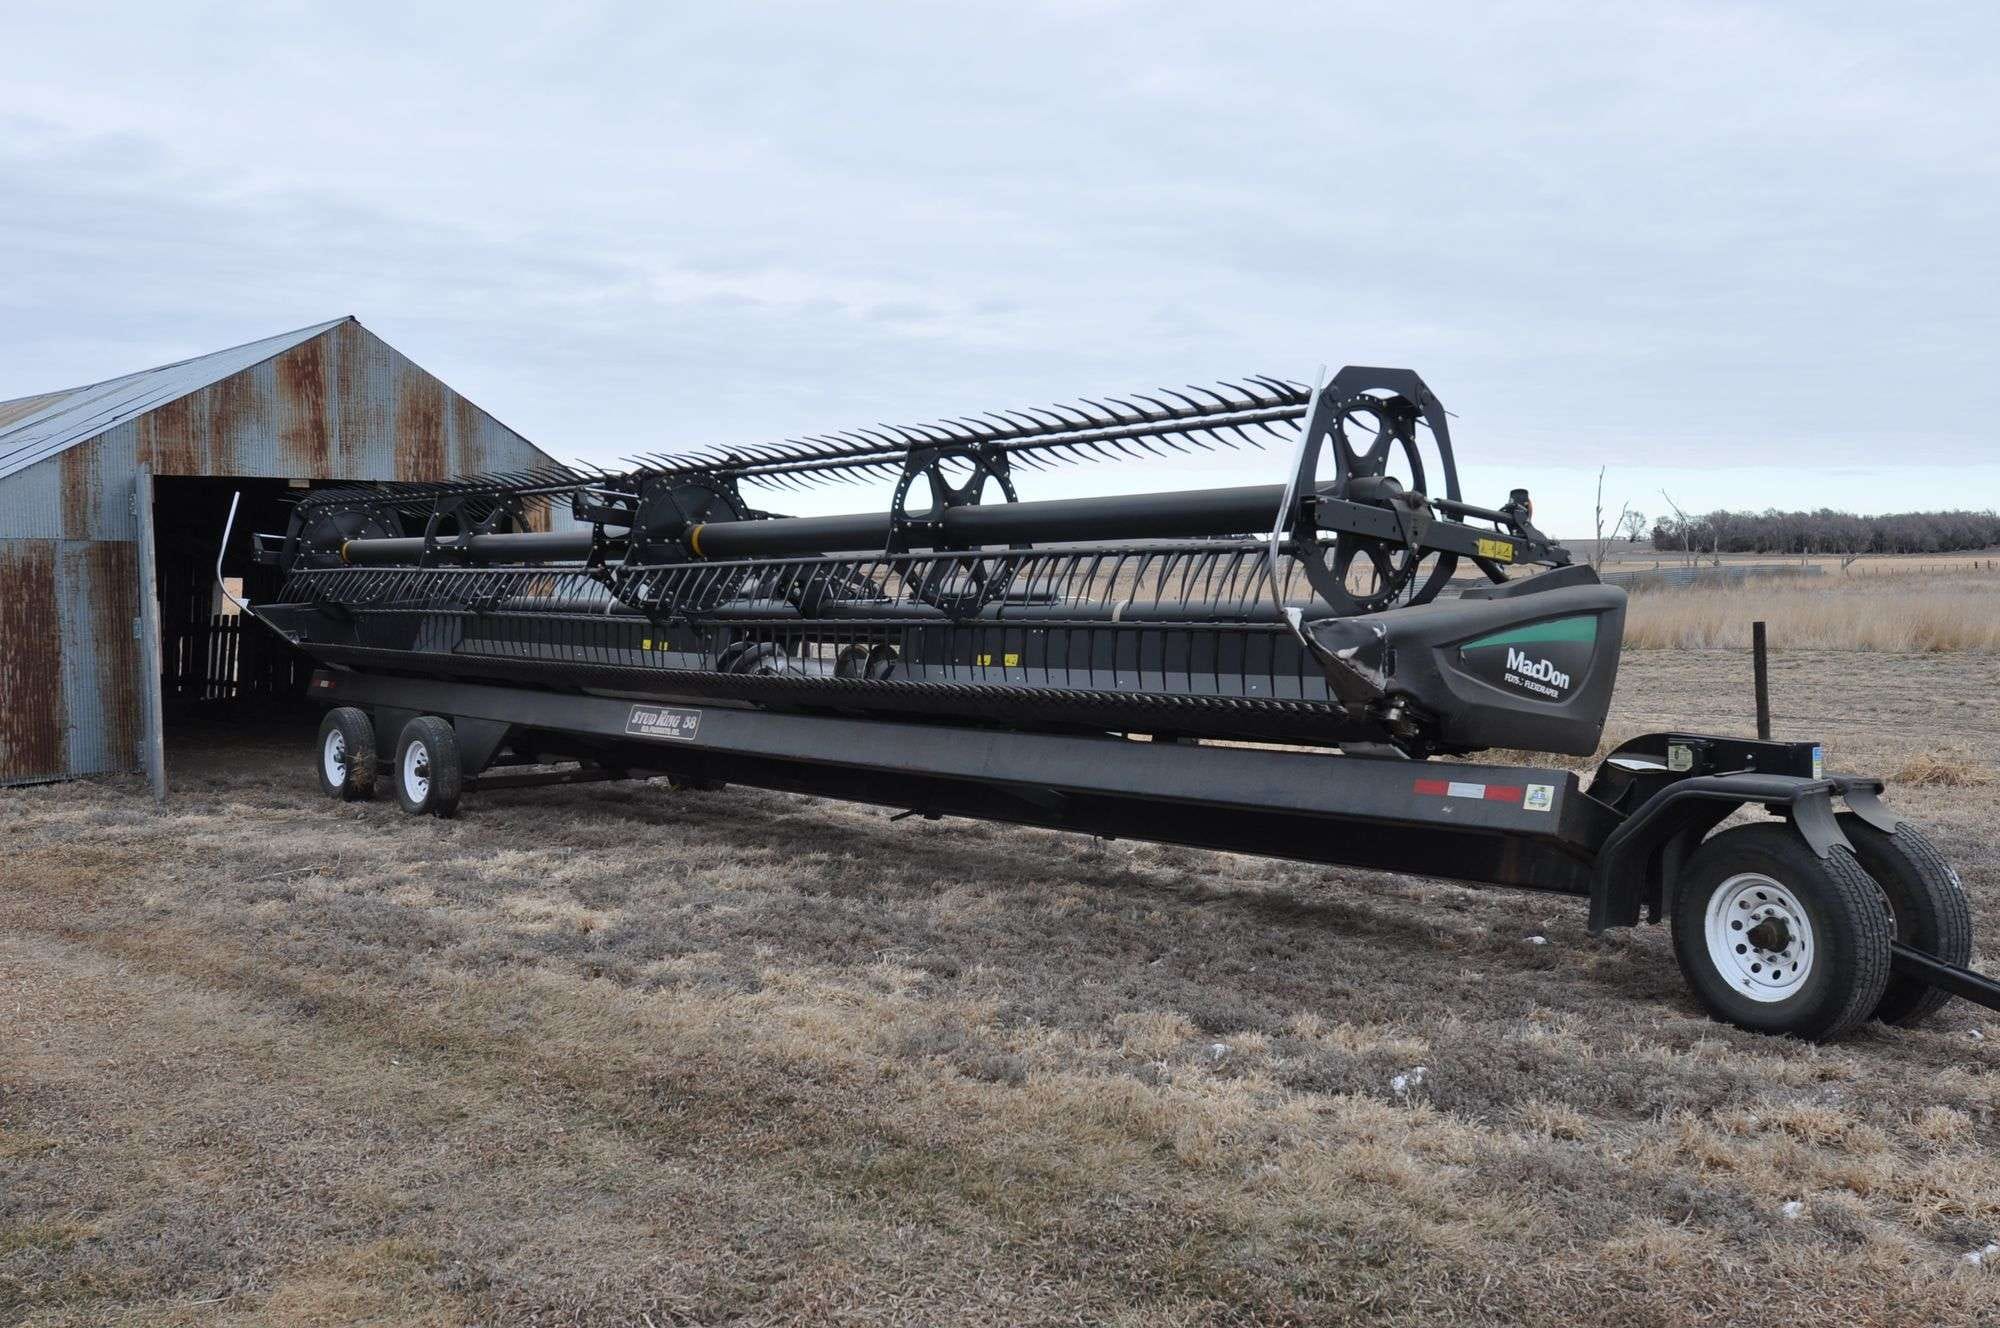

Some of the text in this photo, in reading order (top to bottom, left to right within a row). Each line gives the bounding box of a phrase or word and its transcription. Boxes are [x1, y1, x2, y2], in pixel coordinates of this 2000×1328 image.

[1507, 647, 1570, 689] MacDon
[632, 711, 657, 725] STUD
[655, 710, 681, 728] KING
